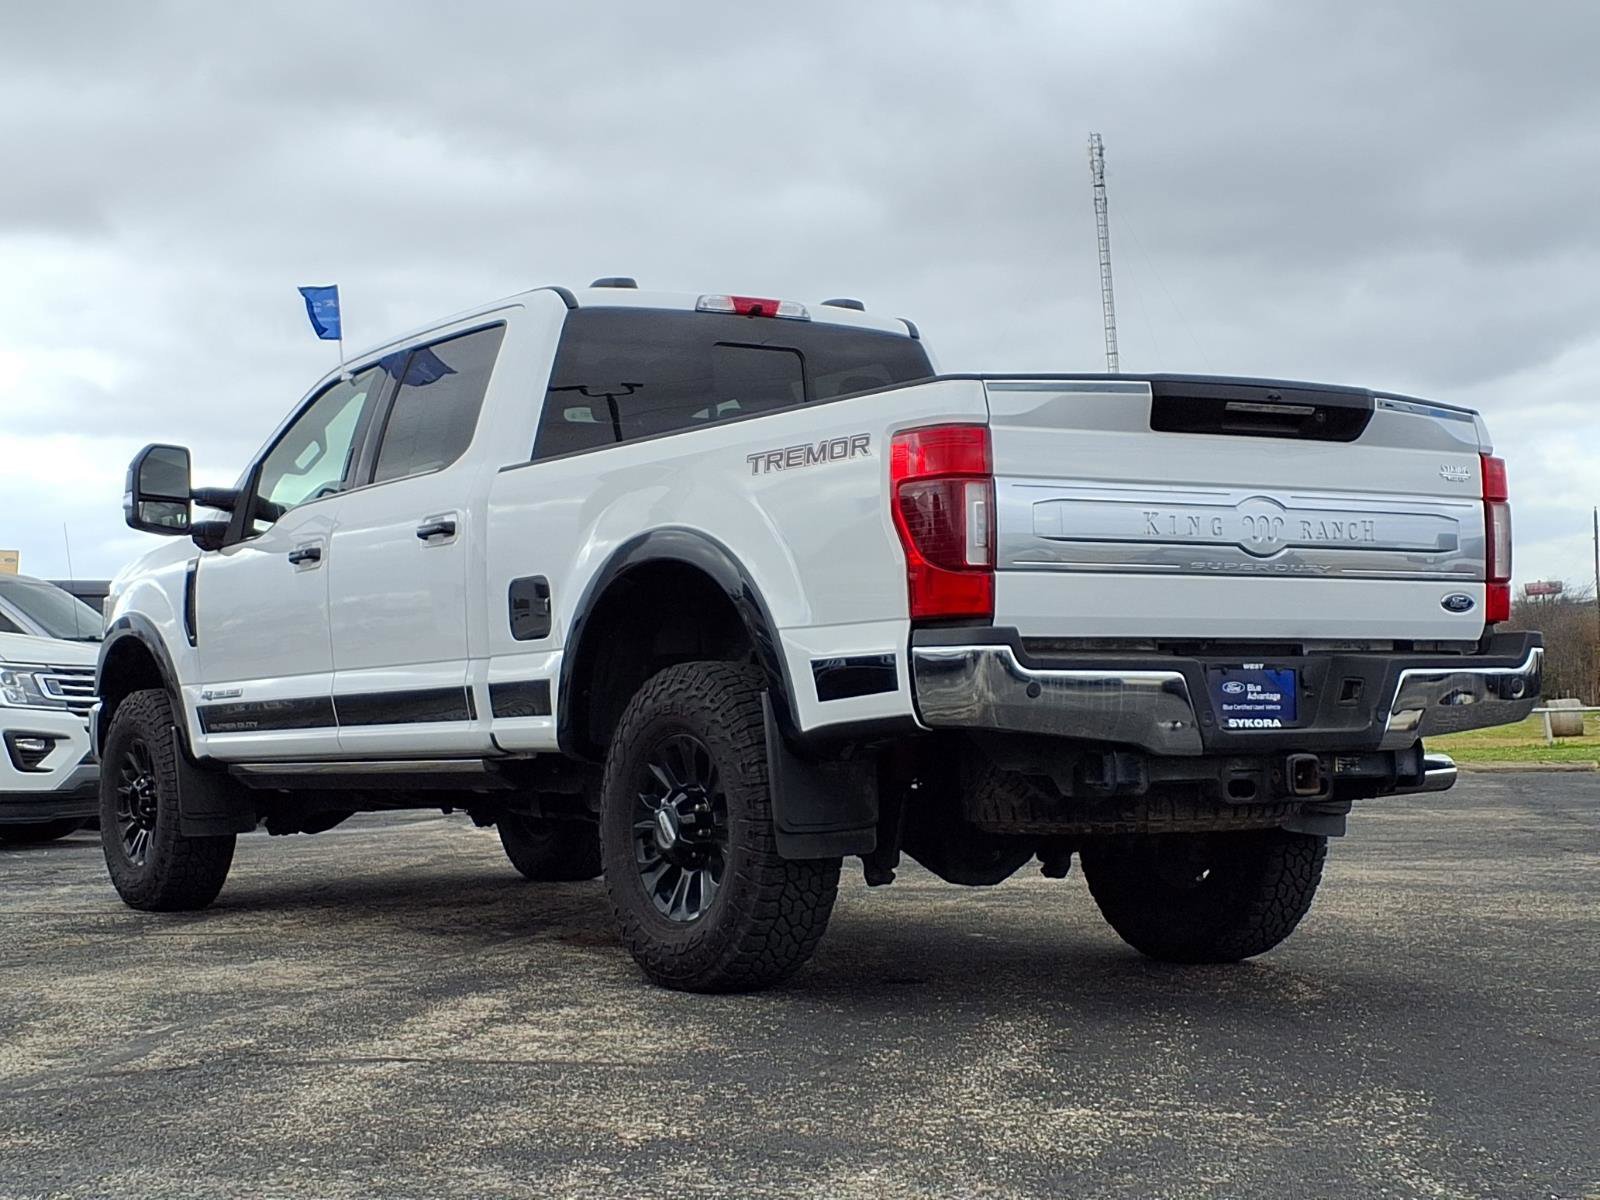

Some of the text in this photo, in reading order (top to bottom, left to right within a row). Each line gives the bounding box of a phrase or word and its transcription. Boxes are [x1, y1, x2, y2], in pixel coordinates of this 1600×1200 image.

[746, 433, 872, 476] TREMOR
[1143, 512, 1376, 542] KING RANCH
[1189, 561, 1332, 576] SUPER DUTY
[238, 721, 258, 729] DUTY
[1228, 719, 1282, 728] SYKORA
